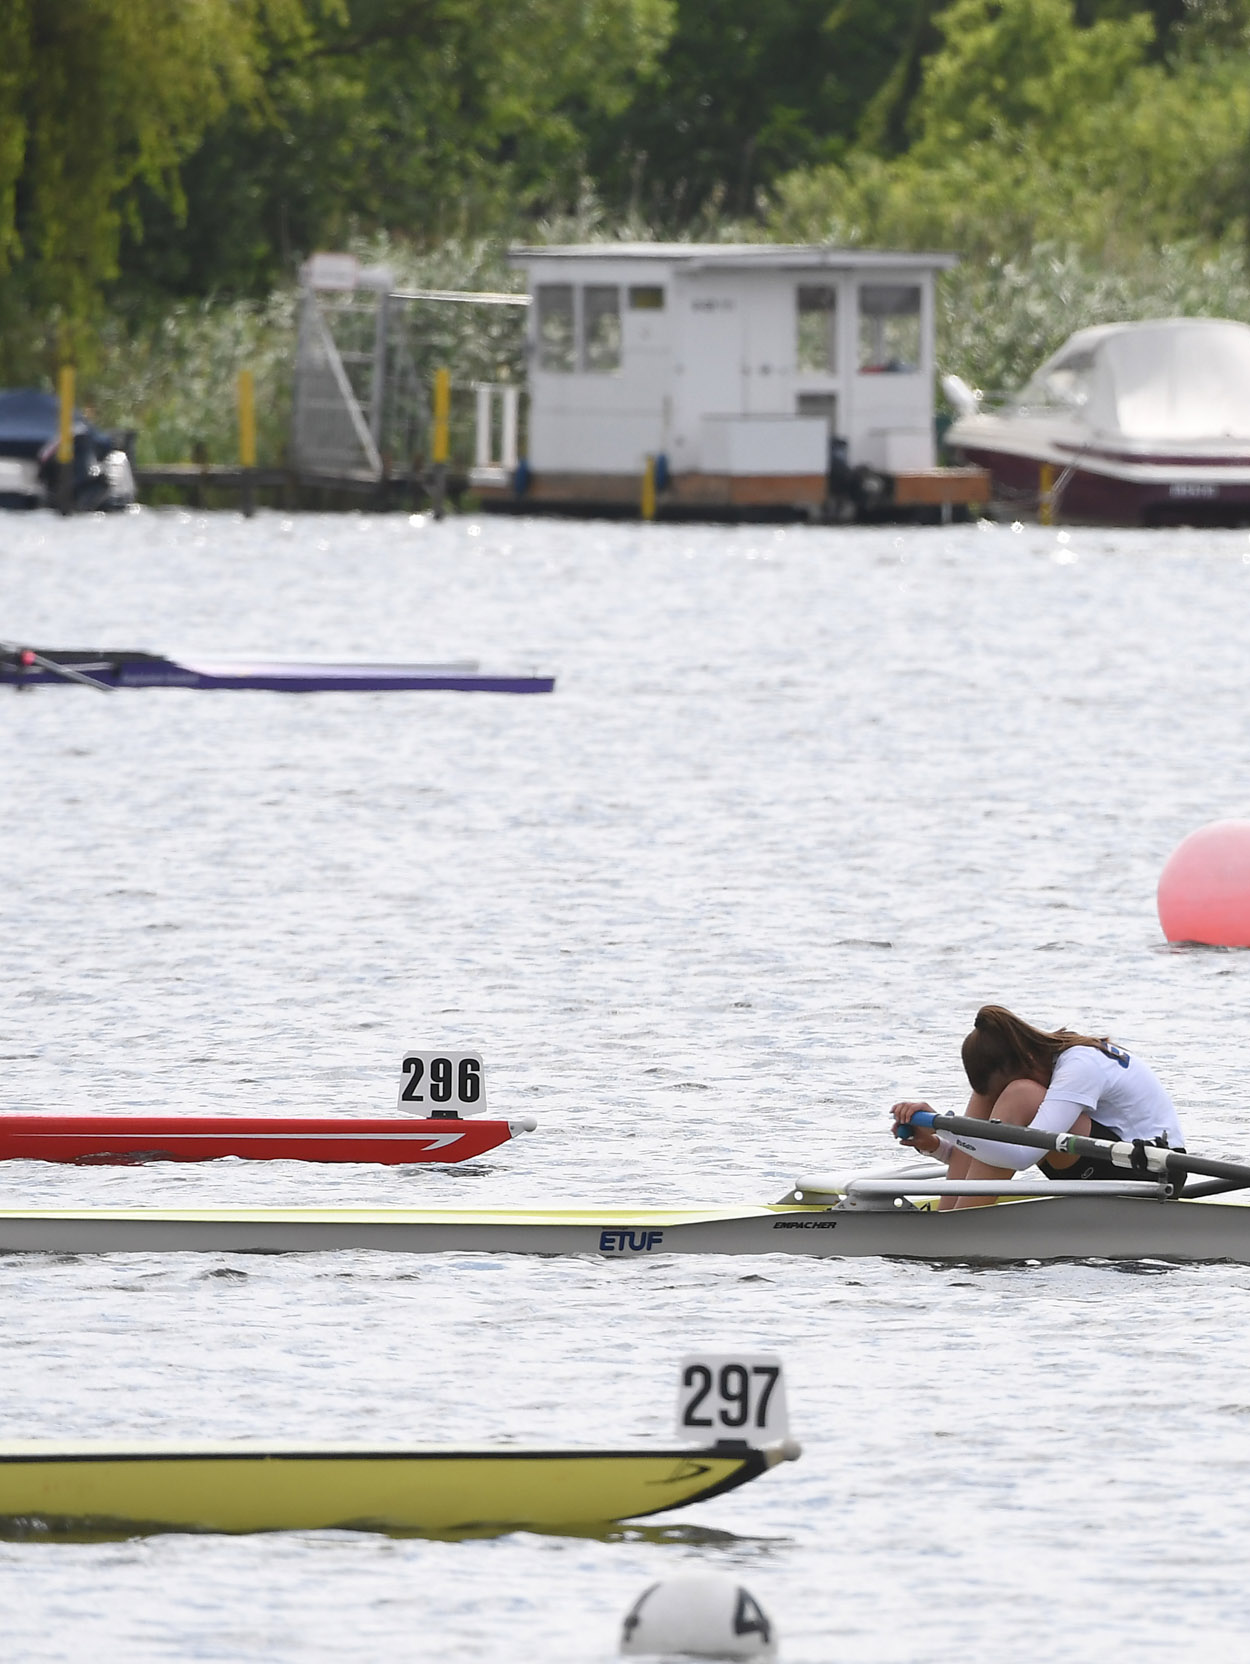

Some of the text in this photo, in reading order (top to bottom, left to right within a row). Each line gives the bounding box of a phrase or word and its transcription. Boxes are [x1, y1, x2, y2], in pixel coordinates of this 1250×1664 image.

[402, 1057, 480, 1103] 296
[599, 1231, 664, 1251] ETUF
[773, 1221, 837, 1229] EMPACHER
[683, 1364, 780, 1428] 297
[733, 1585, 770, 1644] 4
